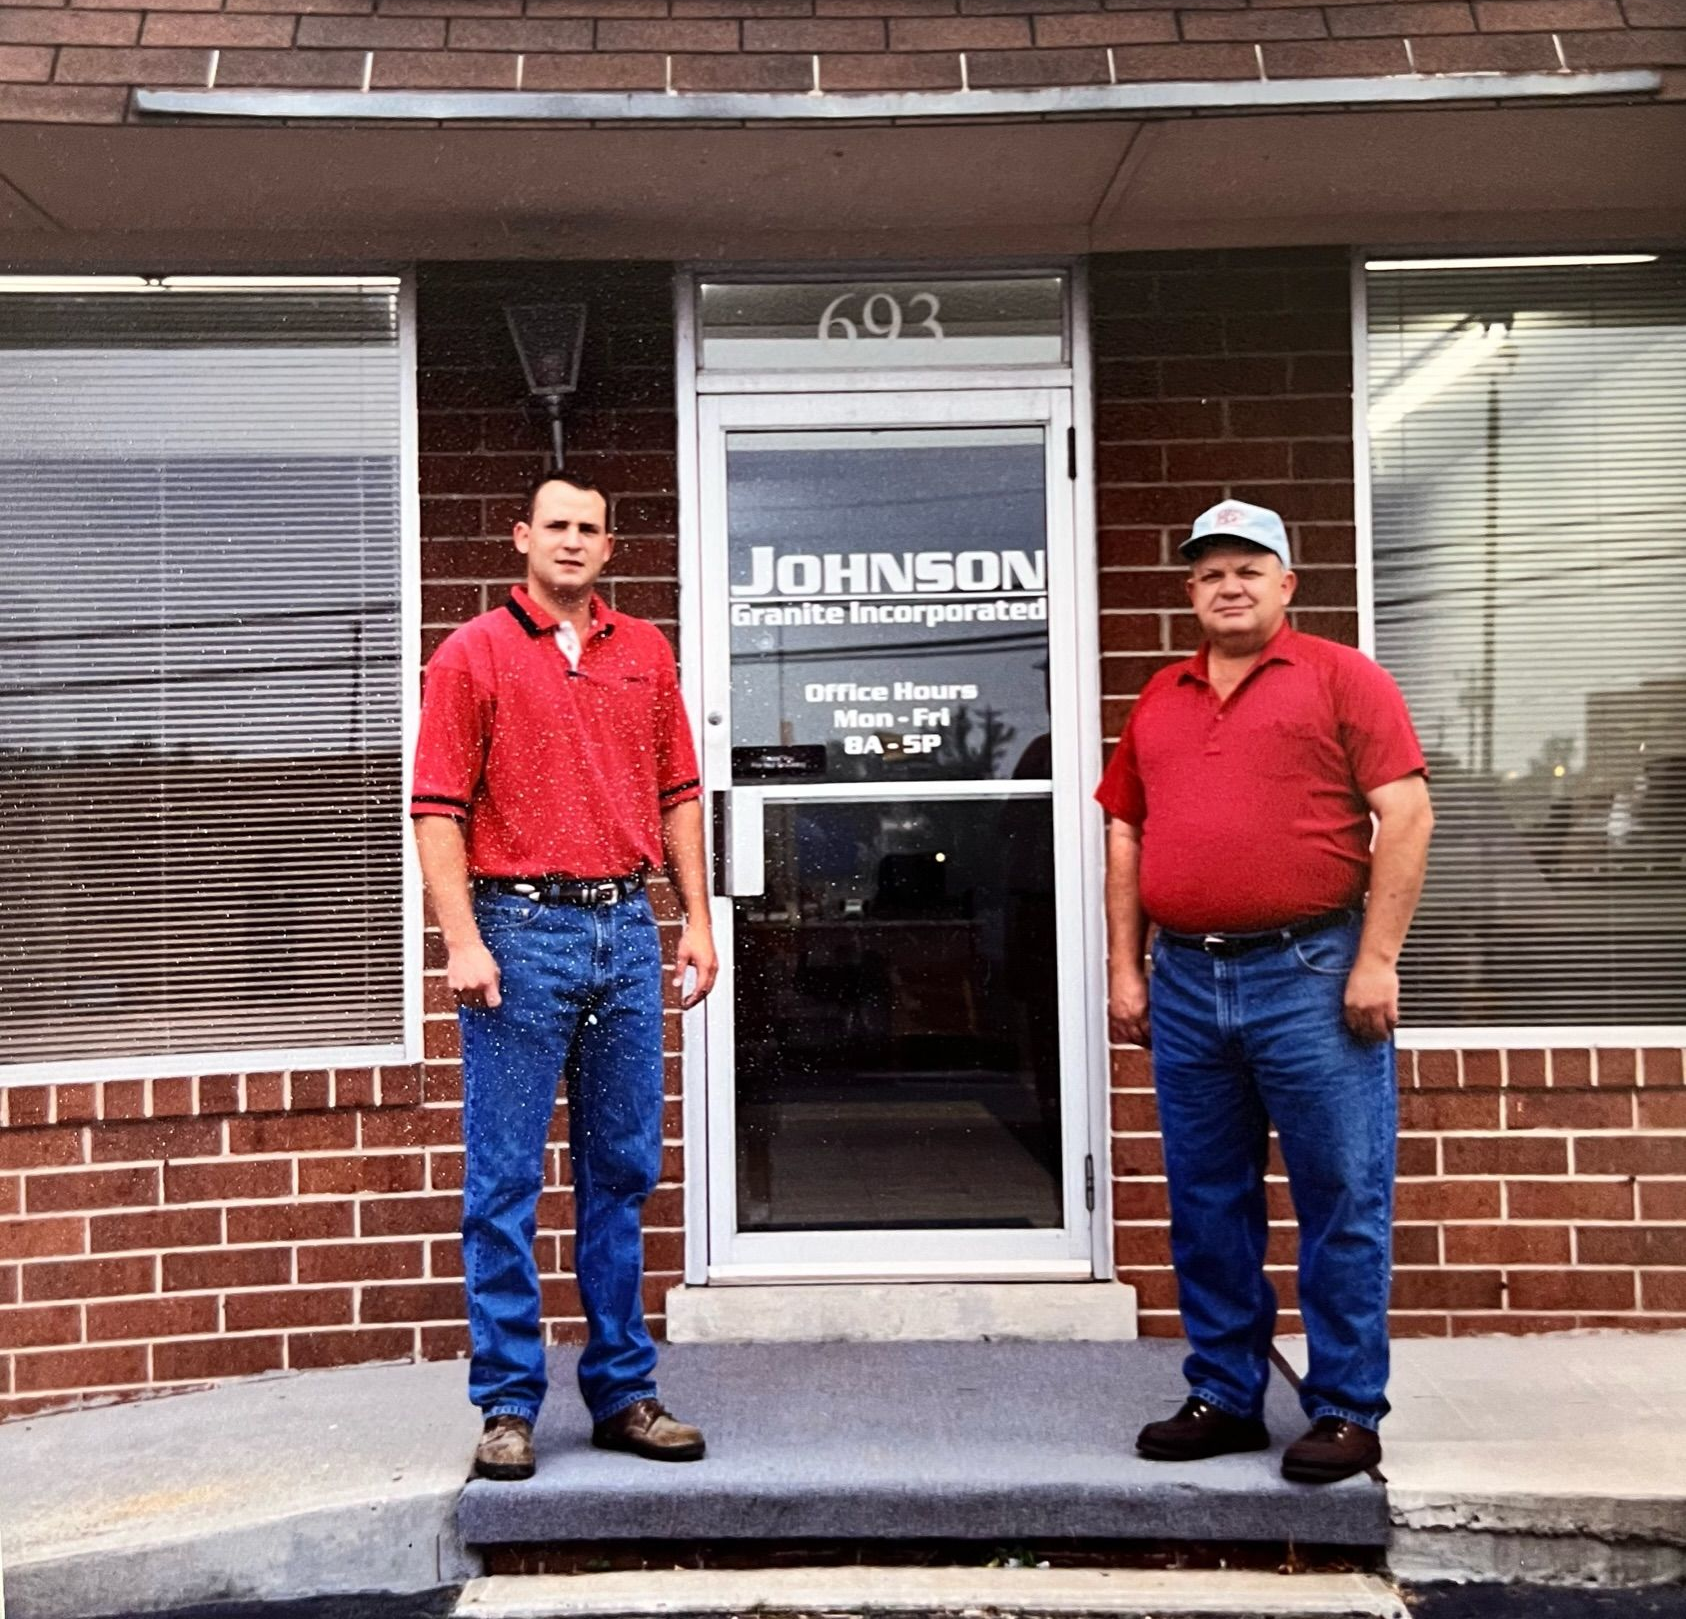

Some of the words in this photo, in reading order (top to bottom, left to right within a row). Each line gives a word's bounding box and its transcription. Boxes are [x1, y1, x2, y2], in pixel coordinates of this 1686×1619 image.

[818, 292, 946, 341] 693
[730, 546, 1046, 596] JOHNSON
[731, 602, 845, 627] Granite
[850, 597, 1047, 627] Incorporated
[805, 683, 889, 702] Office
[893, 681, 978, 701] Hours
[833, 708, 894, 728] Mon
[912, 706, 950, 727] Fri
[844, 734, 884, 755] 8A
[902, 733, 942, 754] 5P
